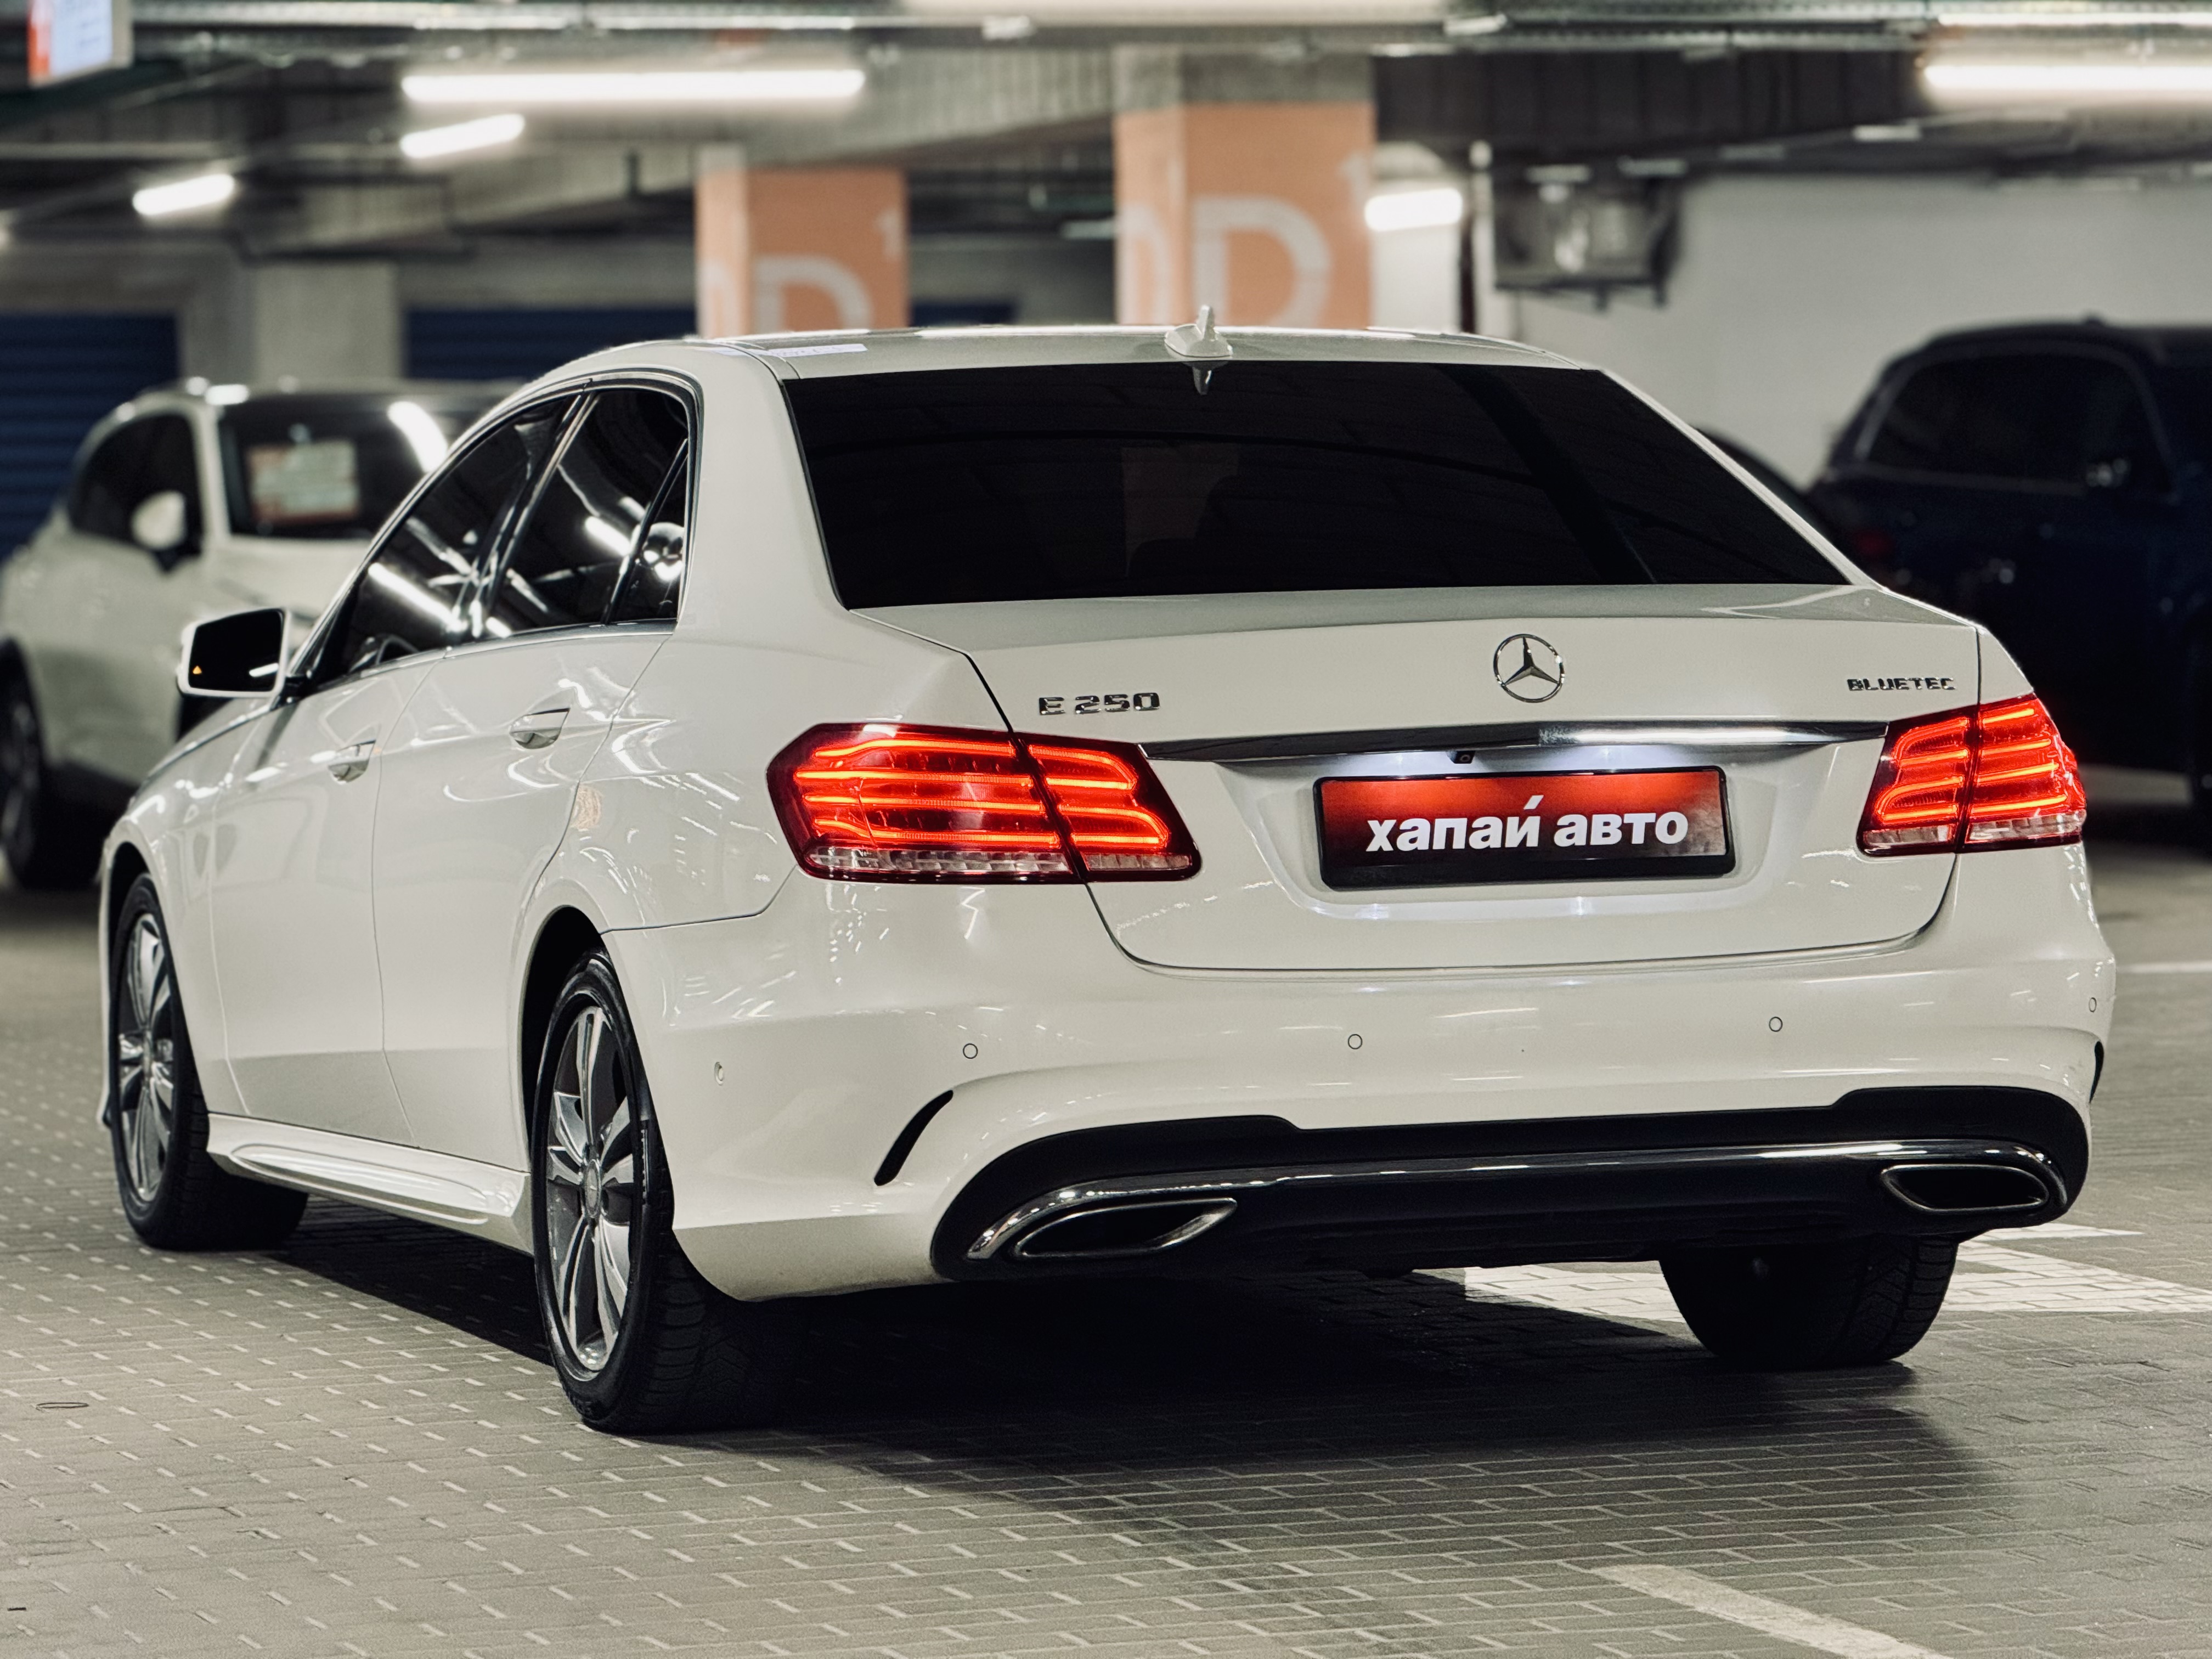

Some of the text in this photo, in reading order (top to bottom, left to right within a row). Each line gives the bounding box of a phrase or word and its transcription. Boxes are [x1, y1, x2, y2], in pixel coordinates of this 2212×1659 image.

[1847, 677, 1956, 691] BLUETEC
[1039, 692, 1160, 715] E 250
[1554, 811, 1689, 847] авто
